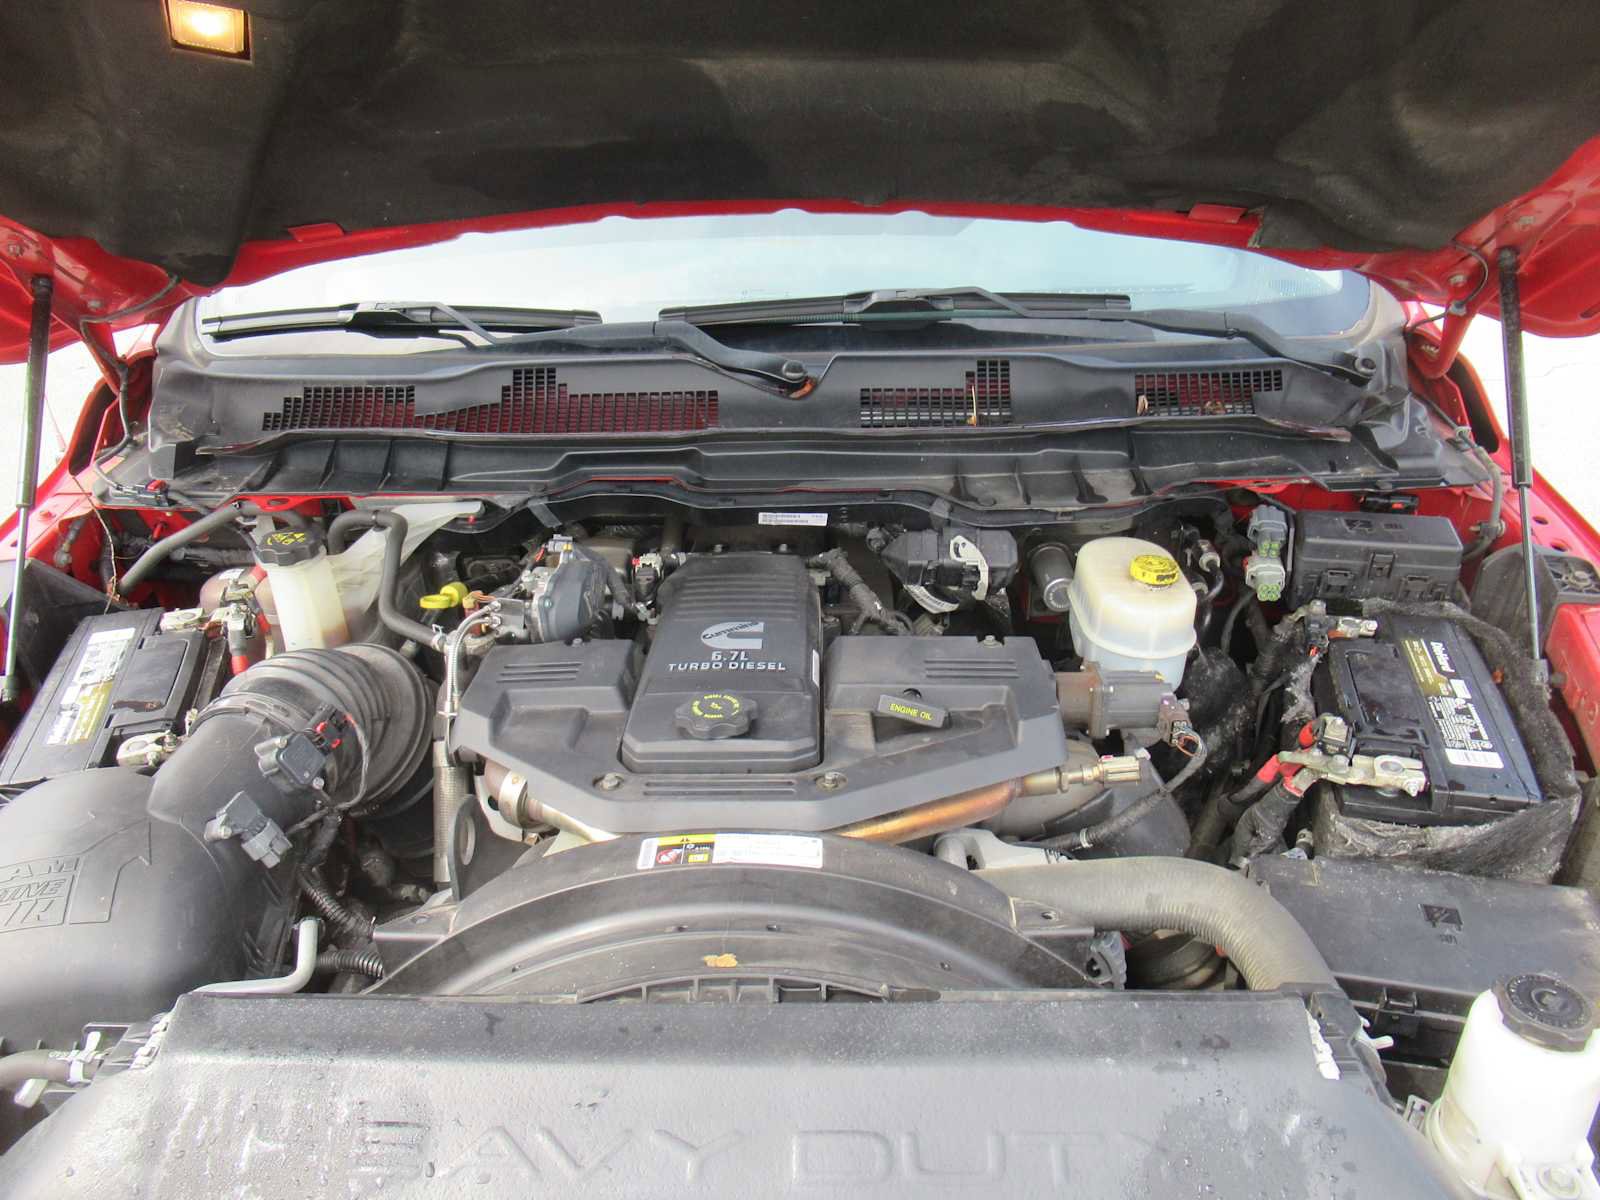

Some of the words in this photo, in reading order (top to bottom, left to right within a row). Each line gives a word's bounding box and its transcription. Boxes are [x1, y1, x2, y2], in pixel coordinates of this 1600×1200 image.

[701, 621, 761, 640] Cummins
[711, 650, 749, 661] 6.7L
[668, 661, 722, 671] TURBO
[728, 661, 786, 671] DIESEL
[889, 703, 919, 717] ENGINE
[920, 711, 933, 721] OIL
